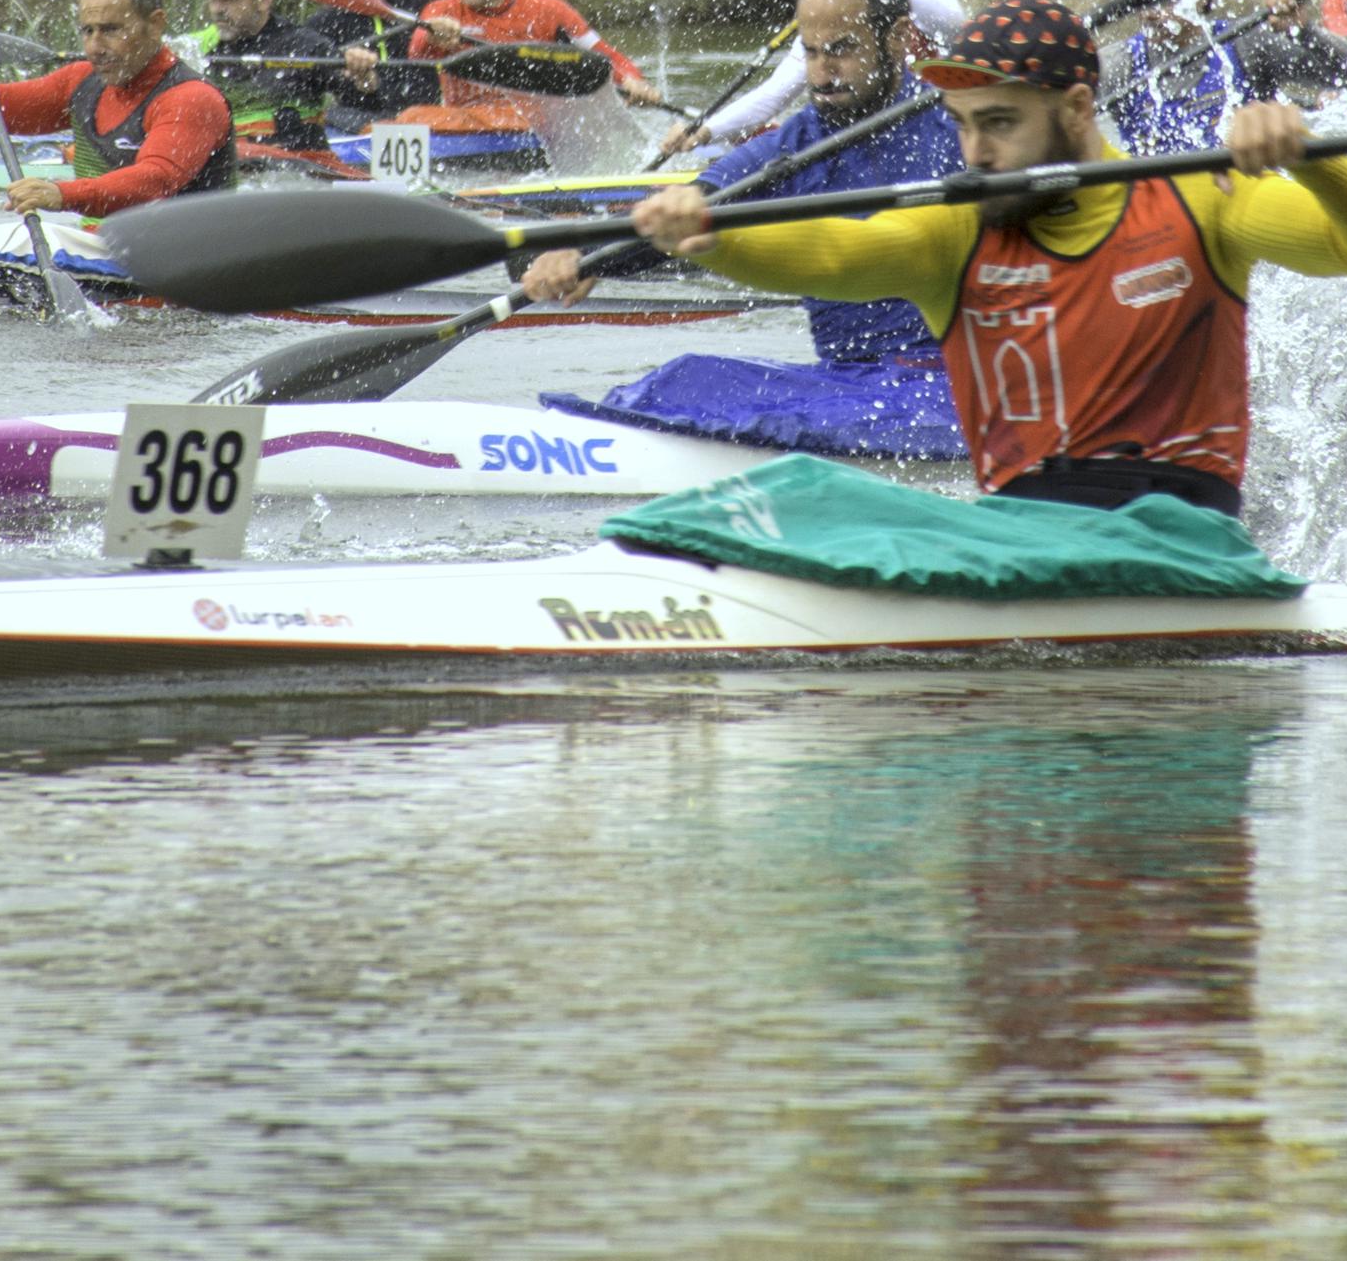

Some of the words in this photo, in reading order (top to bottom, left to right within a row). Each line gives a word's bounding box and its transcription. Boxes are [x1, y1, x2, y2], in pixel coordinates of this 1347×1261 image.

[379, 137, 423, 176] 403
[129, 428, 245, 515] 368
[480, 429, 619, 476] SONIC
